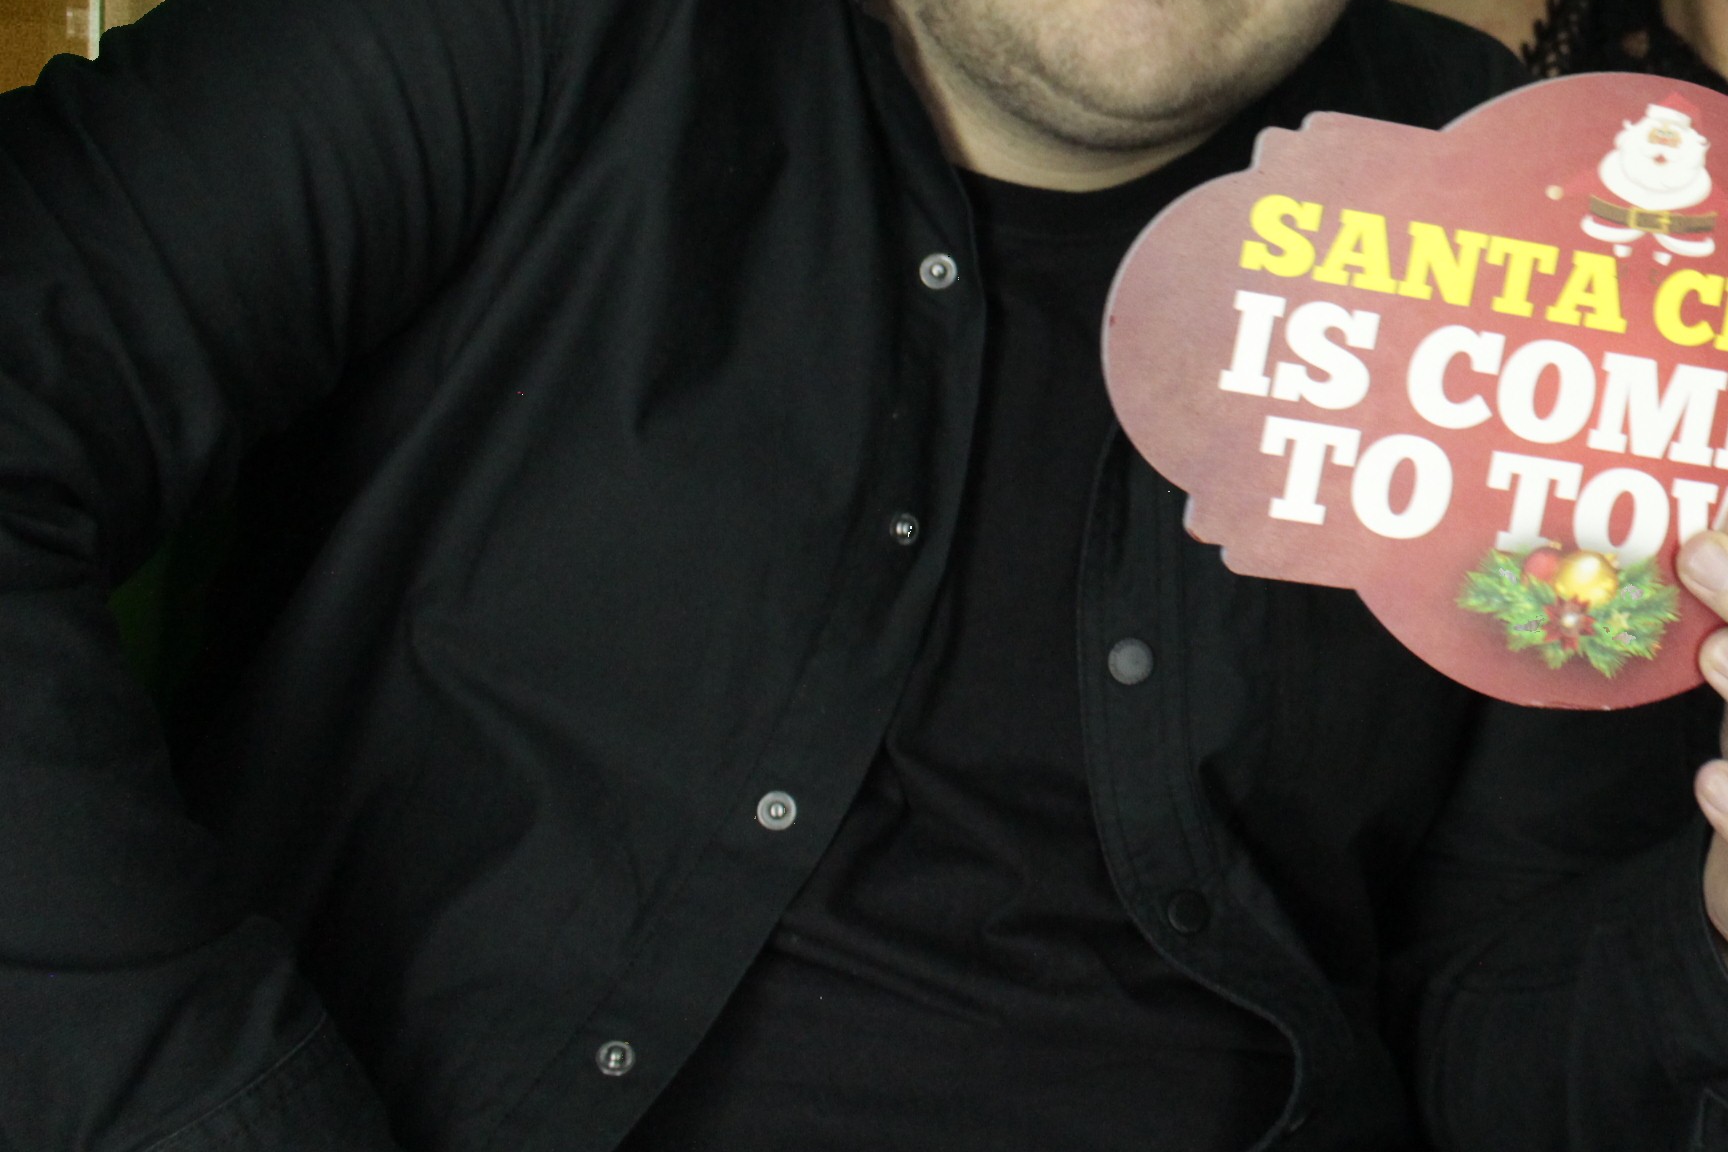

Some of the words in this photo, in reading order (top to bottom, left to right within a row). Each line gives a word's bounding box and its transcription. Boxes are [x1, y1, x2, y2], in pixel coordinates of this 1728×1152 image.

[1237, 192, 1628, 334] SANTA
[1216, 288, 1382, 411] IS
[1258, 414, 1454, 541] TO
